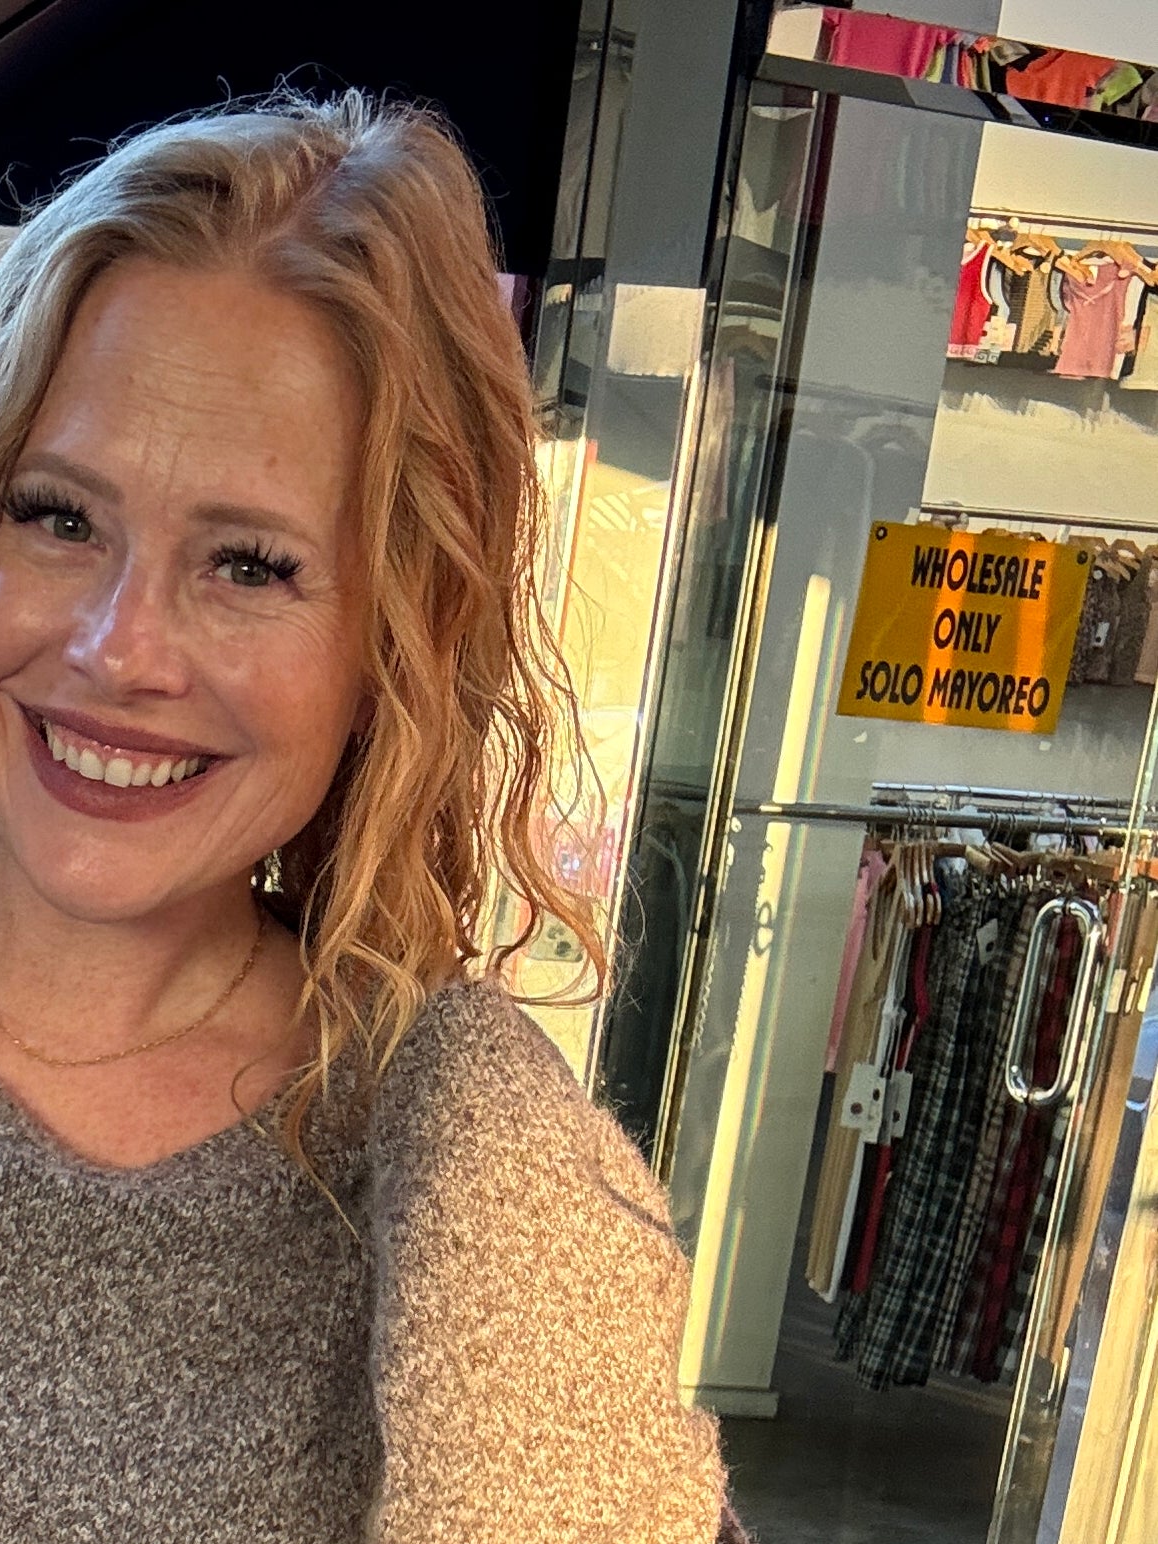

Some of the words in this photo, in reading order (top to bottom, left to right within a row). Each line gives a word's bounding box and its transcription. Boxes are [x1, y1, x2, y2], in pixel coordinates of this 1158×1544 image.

[911, 545, 1046, 600] WHOLESALE
[934, 608, 1002, 654] ONLY
[856, 661, 924, 705] SOLO
[927, 668, 1051, 717] MAYOREO
